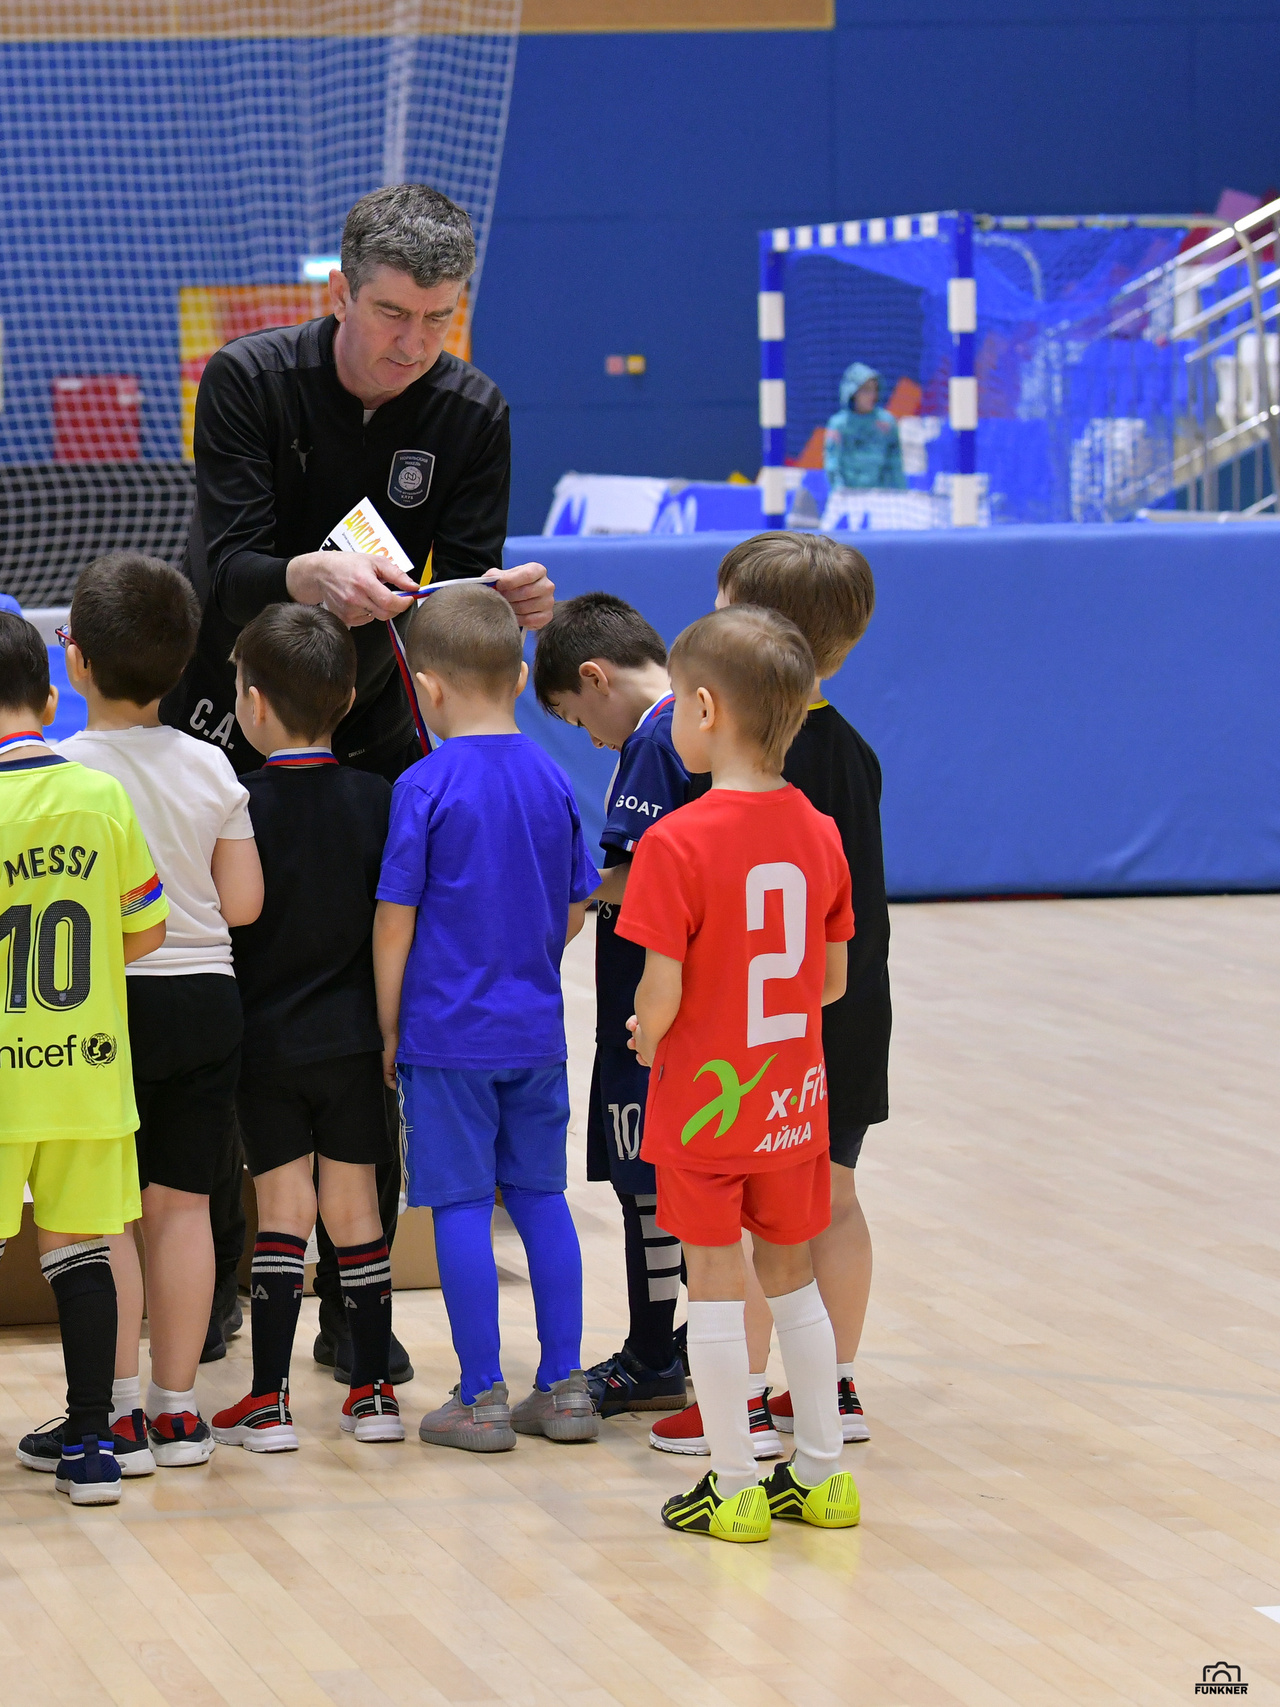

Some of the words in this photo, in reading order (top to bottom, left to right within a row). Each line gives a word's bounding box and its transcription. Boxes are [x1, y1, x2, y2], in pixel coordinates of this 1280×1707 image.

[615, 794, 663, 819] GOAT
[3, 844, 99, 888] MESSI
[745, 862, 808, 1049] 2
[607, 1102, 642, 1161] 10
[753, 1121, 812, 1153] АЙКА
